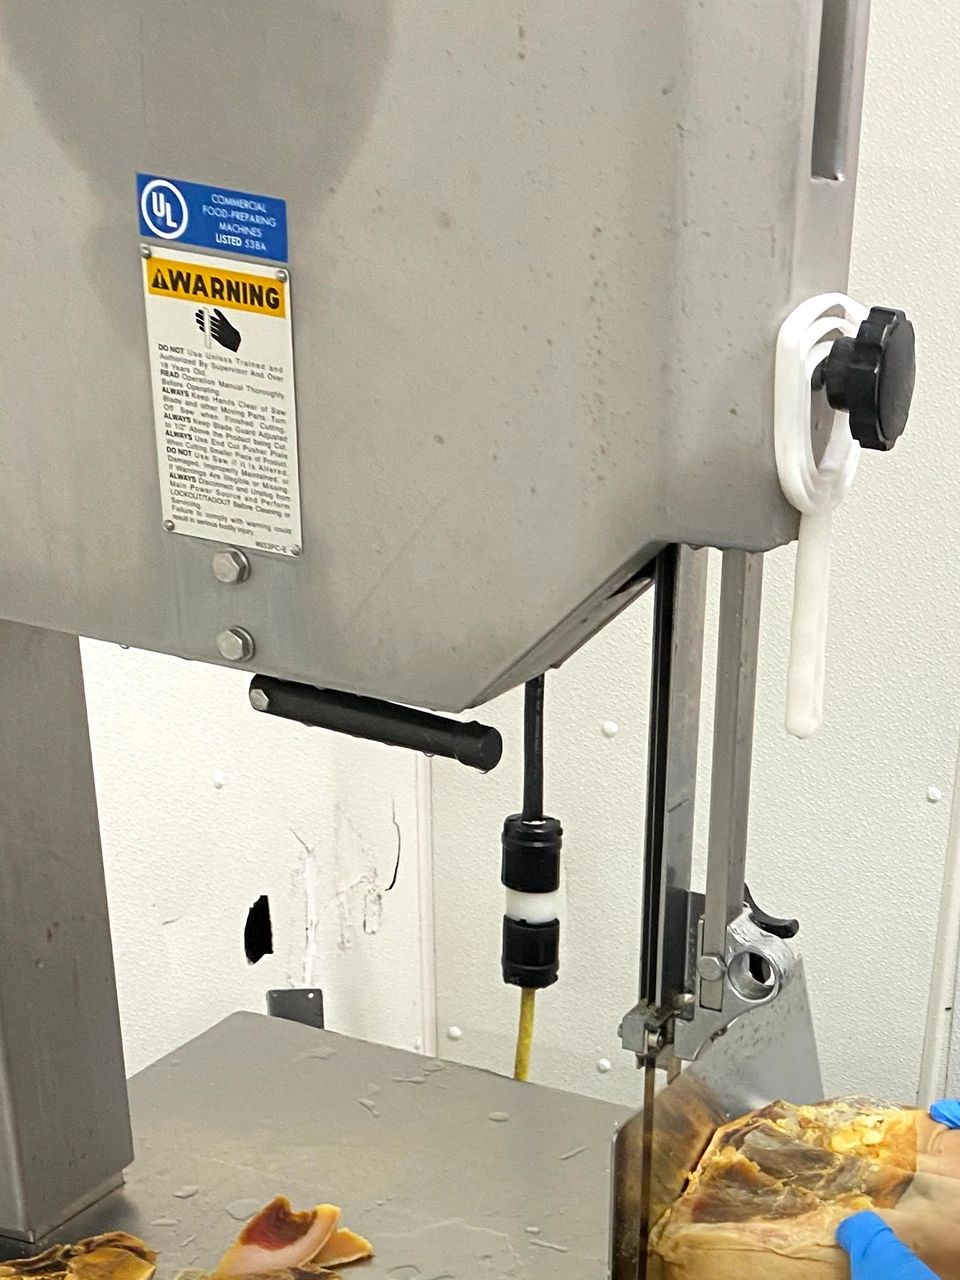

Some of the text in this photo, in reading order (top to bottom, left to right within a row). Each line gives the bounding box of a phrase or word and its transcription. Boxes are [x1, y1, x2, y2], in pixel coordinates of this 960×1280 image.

[211, 193, 267, 213] COMMERCIAL
[151, 191, 178, 229] UL
[202, 204, 277, 227] FOOD-PREPARING
[219, 222, 263, 238] MACHINES
[215, 233, 243, 247] LISTED
[167, 268, 280, 310] WARNING
[170, 346, 184, 354] NOT
[160, 369, 179, 378] READ
[162, 386, 189, 397] ALWAYS
[164, 412, 191, 423] ALWAYS
[165, 429, 193, 440] ALWAYS
[178, 448, 192, 457] NOT
[169, 472, 196, 482] ALWAYS
